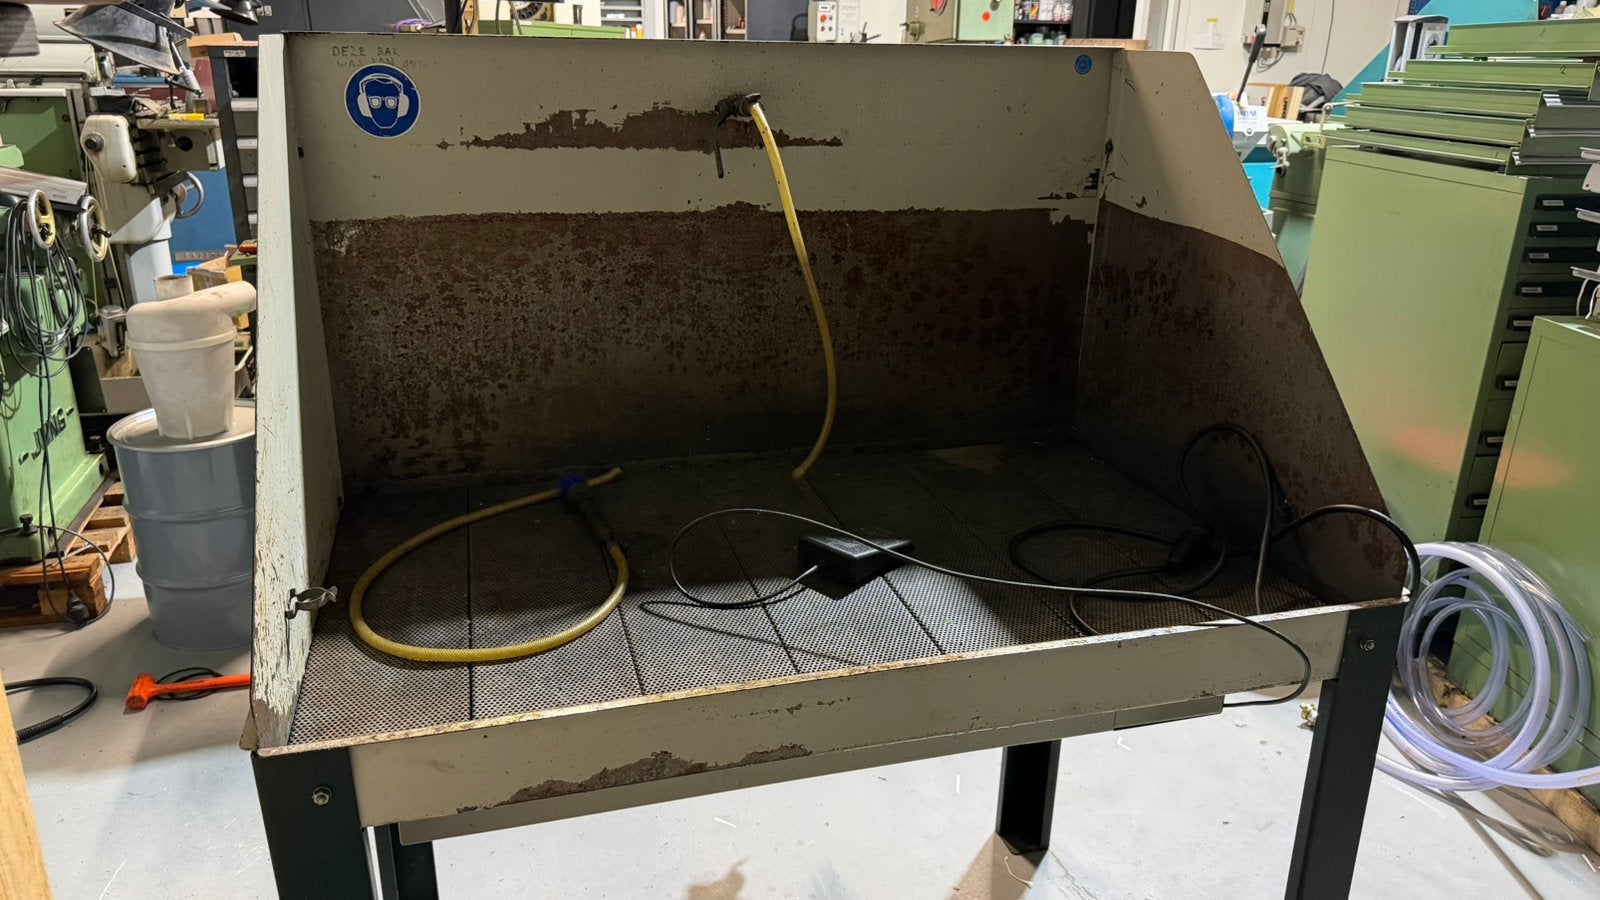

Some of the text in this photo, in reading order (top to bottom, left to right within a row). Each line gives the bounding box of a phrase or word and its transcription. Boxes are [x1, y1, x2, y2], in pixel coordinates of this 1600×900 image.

[332, 45, 401, 57] DEZE BAK
[1560, 65, 1567, 75] 2
